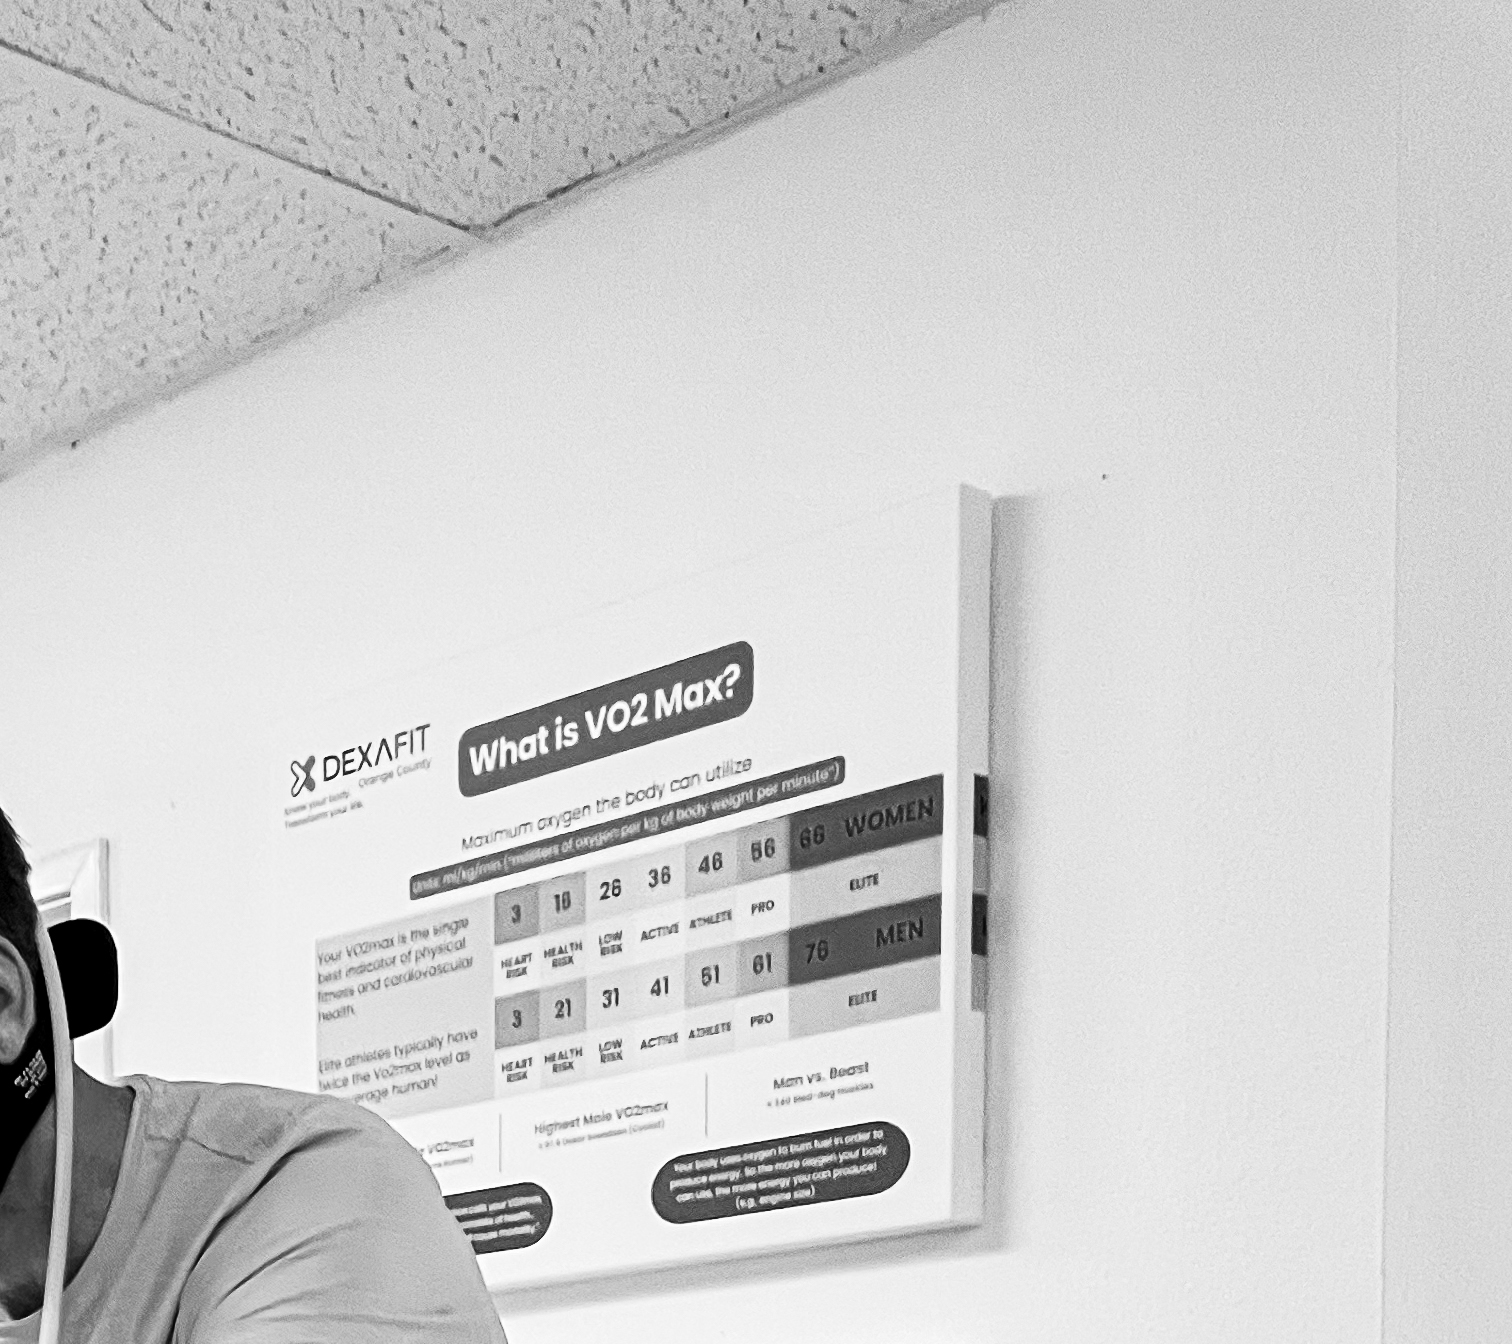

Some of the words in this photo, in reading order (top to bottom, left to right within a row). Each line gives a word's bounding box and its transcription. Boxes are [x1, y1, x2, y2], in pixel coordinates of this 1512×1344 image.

[469, 726, 548, 776] What
[554, 716, 579, 751] is
[585, 692, 648, 740] VO2
[654, 663, 740, 720] Max?
[323, 723, 430, 781] DEXAFIT
[462, 821, 534, 850] Maximum
[538, 804, 590, 832] oxygen
[596, 795, 620, 813] the
[625, 781, 666, 805] body
[670, 772, 701, 792] can
[706, 758, 752, 782] utilize
[600, 879, 621, 900] 26
[648, 866, 671, 888] 36
[698, 852, 723, 874] 46
[845, 795, 934, 837] WOMEN
[850, 873, 879, 891] ELITE
[751, 900, 774, 915] PRO
[599, 930, 622, 947] LOW
[640, 922, 679, 941] ACTIVE
[318, 950, 341, 966] Your
[411, 929, 429, 942] the
[400, 950, 412, 963] of
[415, 937, 466, 963] physical
[544, 941, 582, 958] HEALTH
[501, 953, 532, 969] HEART
[512, 1010, 521, 1028] 3
[555, 998, 571, 1019] 21
[602, 988, 619, 1009] 31
[651, 976, 668, 996] 41
[876, 916, 924, 948] MEN
[358, 978, 381, 994] and
[849, 989, 877, 1006] ELITE
[750, 1013, 773, 1027] PRO
[447, 1028, 478, 1044] have
[640, 1033, 678, 1050] ACTIVE
[599, 1039, 622, 1052] LOW
[544, 1047, 582, 1064] HEALTH
[352, 1068, 370, 1083] the
[456, 1050, 470, 1063] as
[502, 1057, 532, 1073] HEART
[773, 1076, 803, 1090] Man
[830, 1062, 869, 1079] Beast
[355, 1088, 388, 1105] erage
